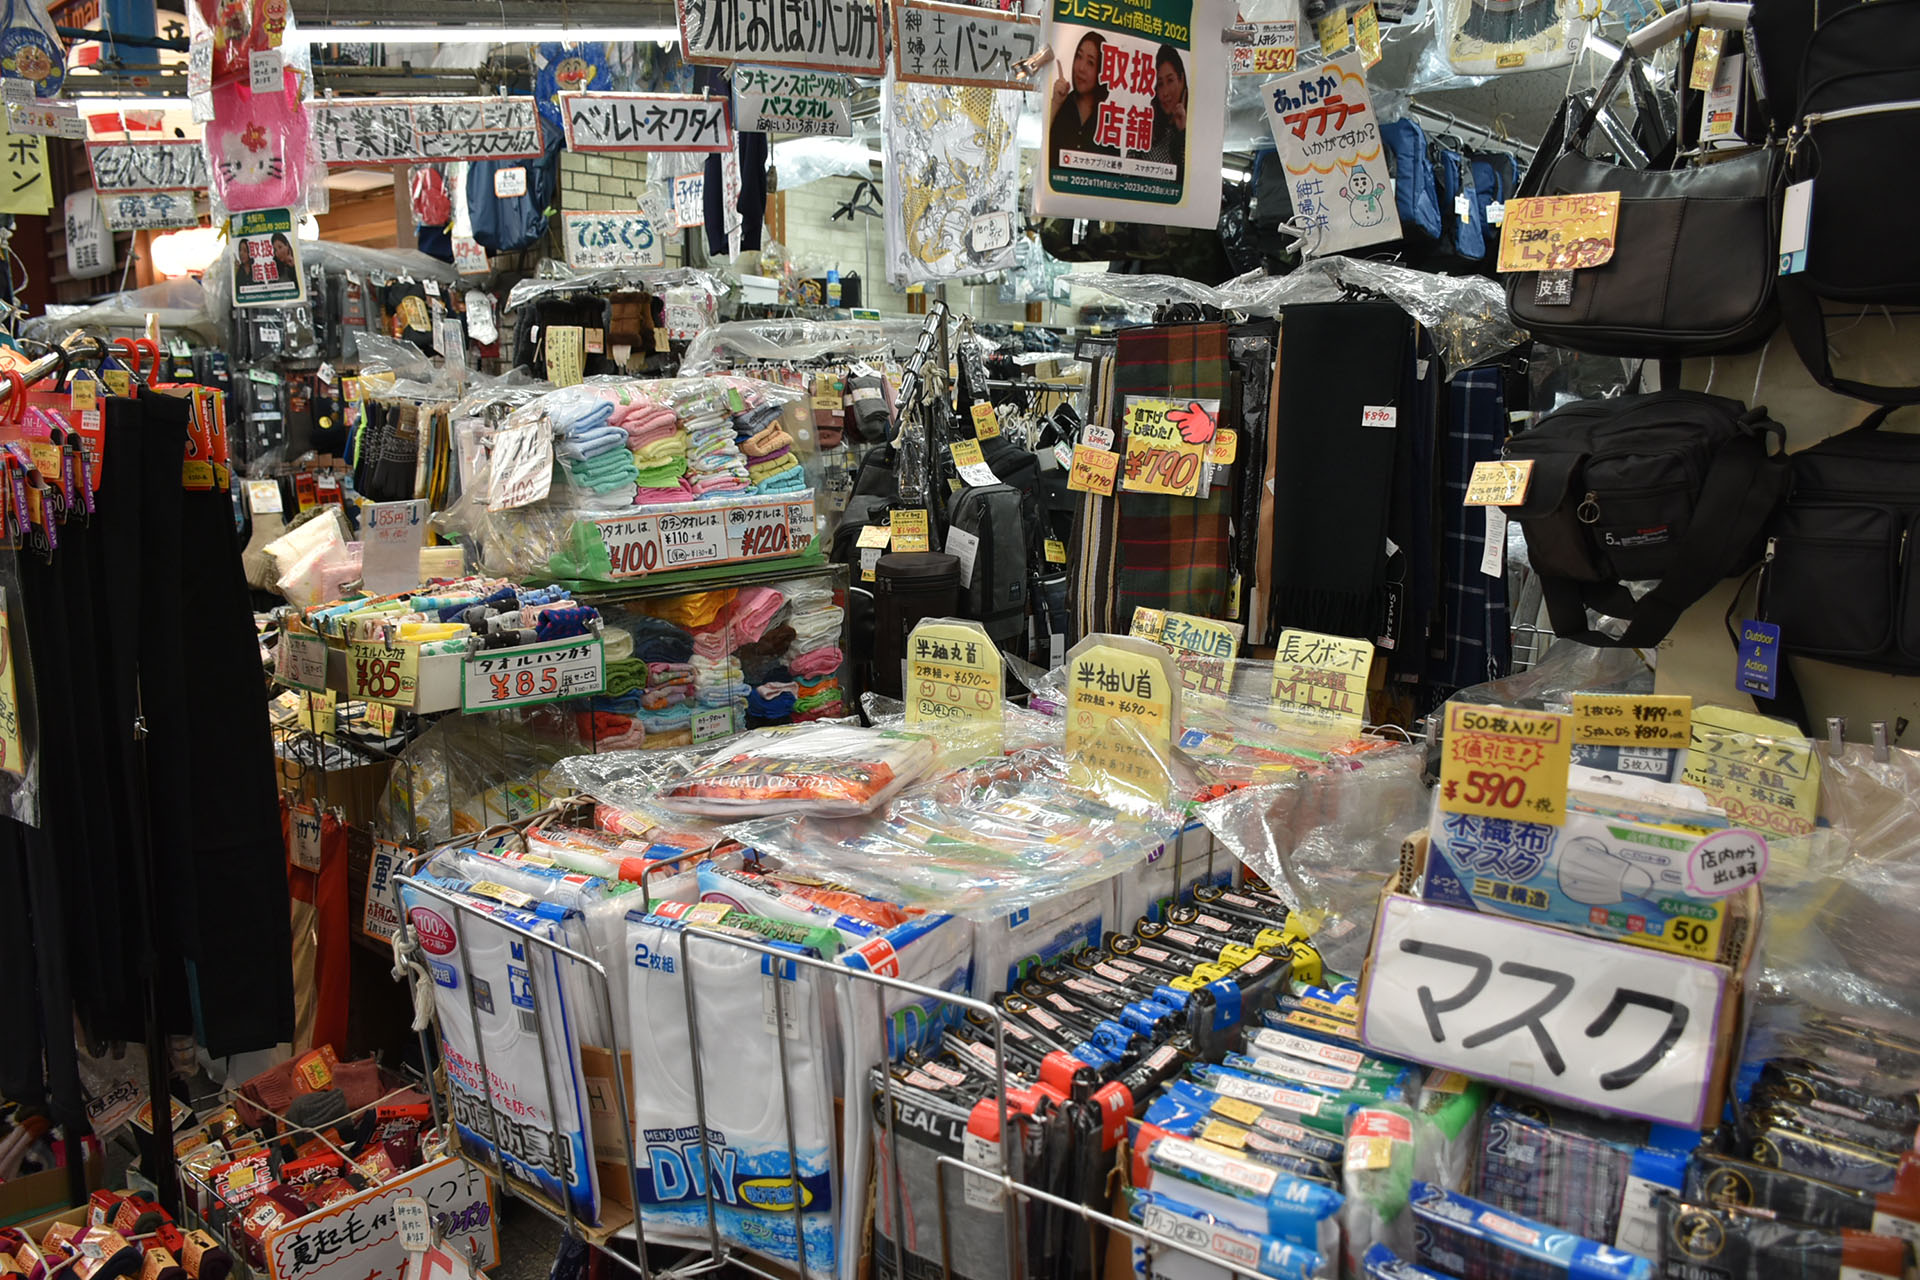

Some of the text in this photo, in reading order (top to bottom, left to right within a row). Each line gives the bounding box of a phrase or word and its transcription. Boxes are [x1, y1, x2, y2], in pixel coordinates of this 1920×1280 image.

[1164, 22, 1188, 43] 2022
[1099, 44, 1155, 97] 取扱
[760, 96, 834, 120] バスタオル
[1273, 75, 1337, 114] あったか
[573, 103, 726, 144] ベルト・ネクタイ
[1094, 102, 1154, 152] 店舗
[1283, 95, 1366, 141] マフラー
[315, 106, 417, 159] 作業服
[1302, 122, 1375, 157] いかがですか?
[8, 135, 42, 192] ボン
[1296, 178, 1325, 199] 紳士
[1297, 196, 1330, 216] 婦人
[570, 218, 654, 250] てぶくろ
[248, 240, 274, 259] 取扱
[252, 261, 279, 281] 店舗
[1538, 278, 1569, 297] 皮革
[1135, 408, 1163, 424] 値下げ
[1365, 411, 1390, 422] ¥890
[1133, 422, 1174, 440] しました!
[1125, 448, 1198, 489] ¥790
[665, 531, 689, 545] ¥110
[741, 523, 787, 556] ¥120
[610, 540, 658, 573] ¥100
[916, 638, 977, 664] 半袖丸首
[1160, 617, 1233, 658] 長袖U首
[1744, 629, 1774, 645] Outdoor
[480, 645, 592, 673] タオルハンカチ
[1279, 635, 1367, 671] 長ズボン下
[1744, 658, 1768, 673] Action
[356, 658, 401, 698] ¥85
[490, 667, 557, 700] ¥85
[1077, 662, 1151, 699] 半袖U首
[1462, 711, 1555, 739] 50枚入り!!
[1622, 759, 1665, 775] 5枚入り
[1444, 769, 1527, 809] ¥590
[1447, 814, 1554, 852] 不織布
[1450, 841, 1540, 878] マスク
[1700, 845, 1755, 870] 店内から
[1713, 862, 1759, 886] 出します
[1473, 878, 1548, 909] 三層構造
[1672, 919, 1708, 945] 50
[509, 940, 526, 962] M
[634, 944, 675, 974] 2枚組
[1400, 938, 1690, 1091] マスク
[644, 1129, 675, 1142] MEN'S
[1285, 1181, 1311, 1203] M
[1268, 1240, 1293, 1266] M
